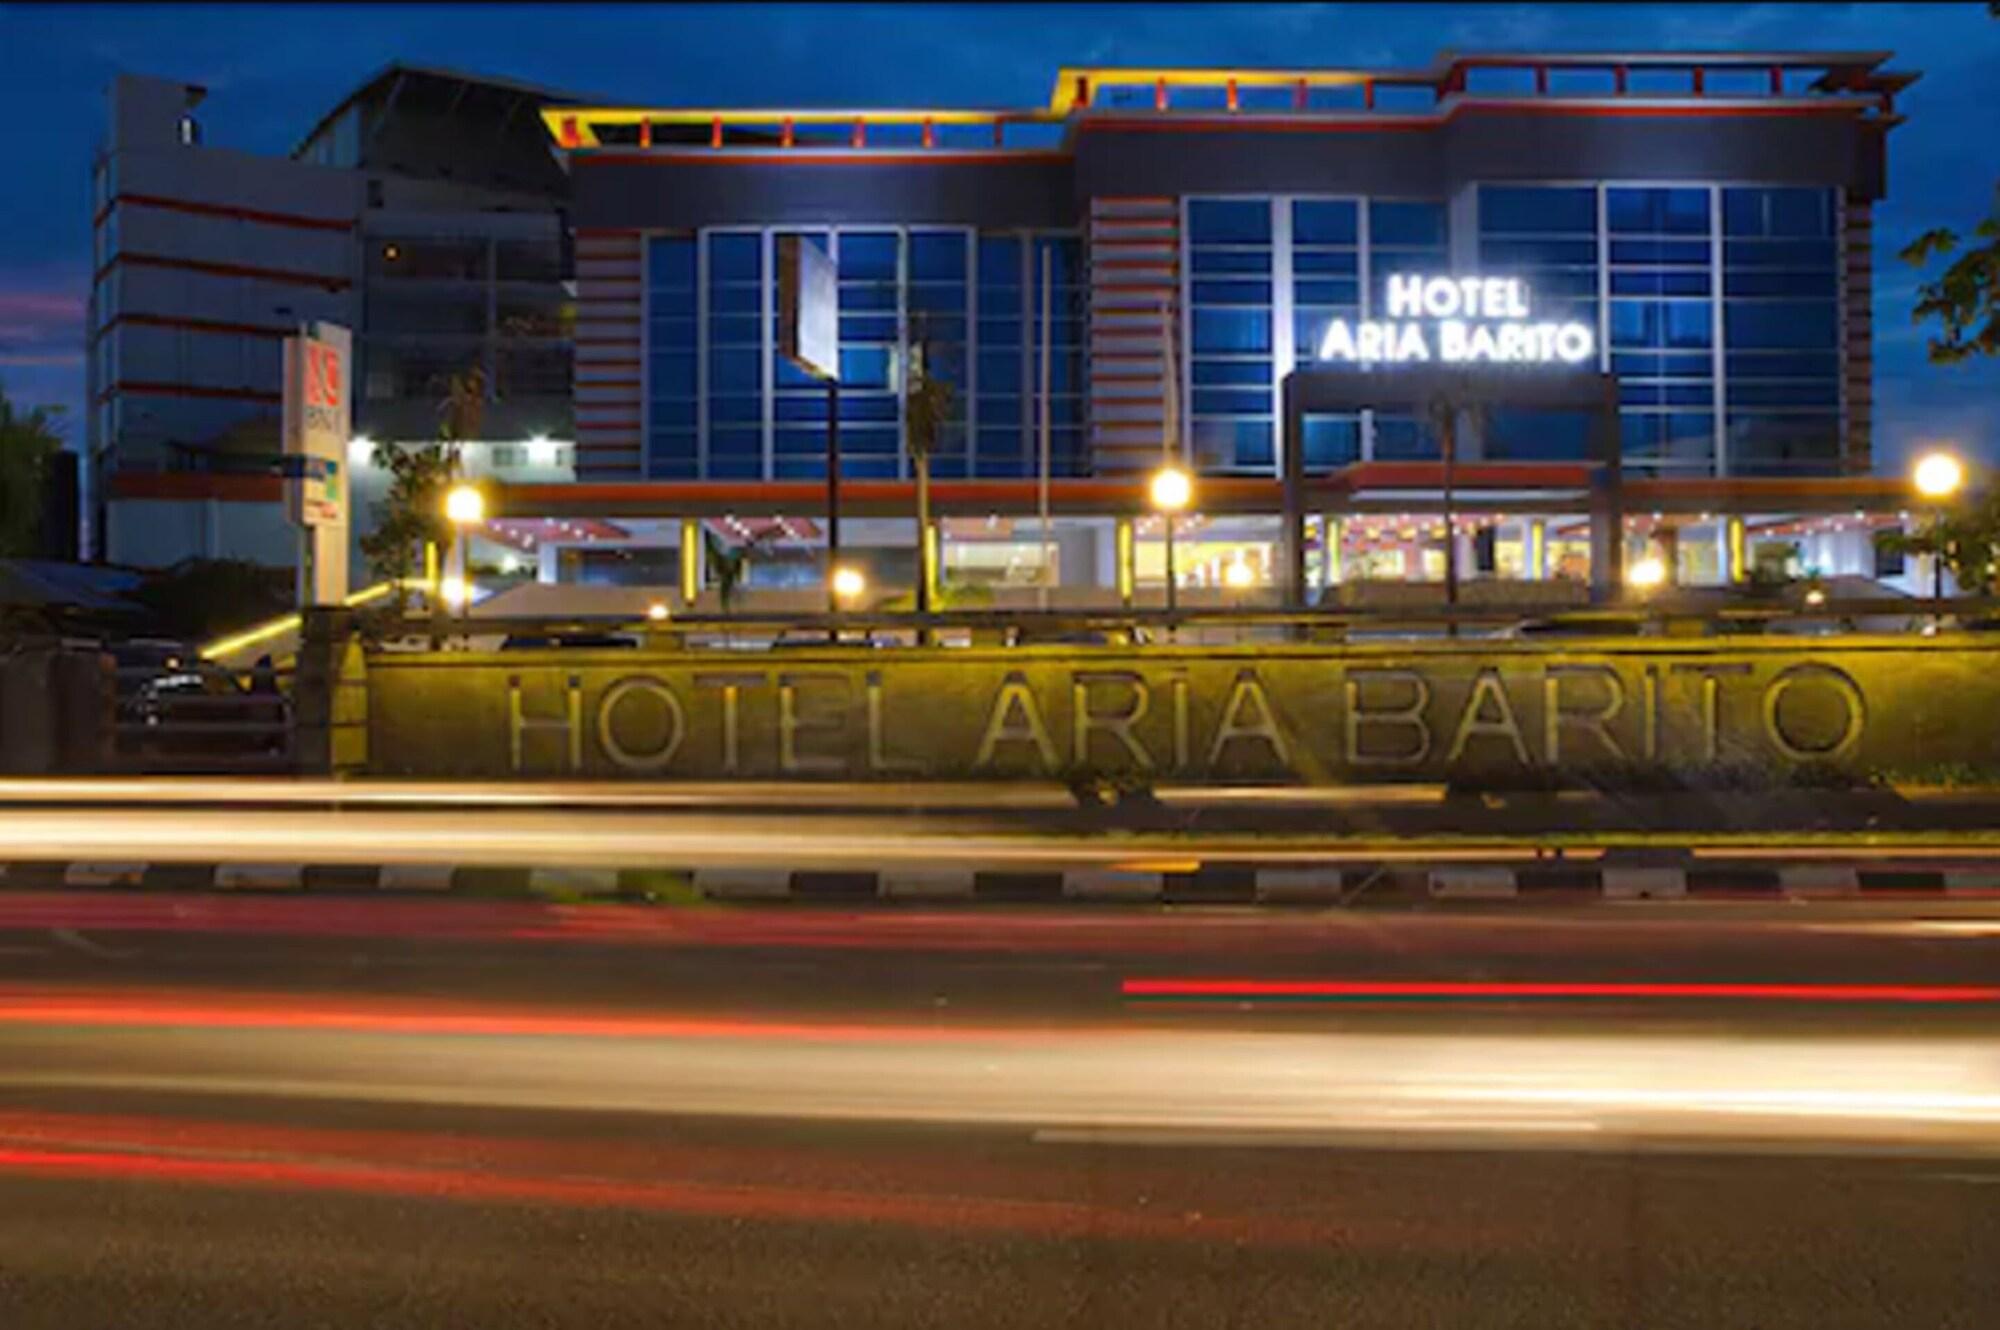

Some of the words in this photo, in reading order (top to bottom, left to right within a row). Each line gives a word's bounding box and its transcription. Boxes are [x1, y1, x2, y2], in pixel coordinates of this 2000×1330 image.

[1387, 274, 1529, 318] HOTEL
[1319, 320, 1430, 362] ARIA
[1439, 320, 1594, 363] BARITO
[508, 672, 928, 772] HOTEL
[976, 664, 1292, 770] ARIA
[1342, 660, 1867, 768] BARITO
